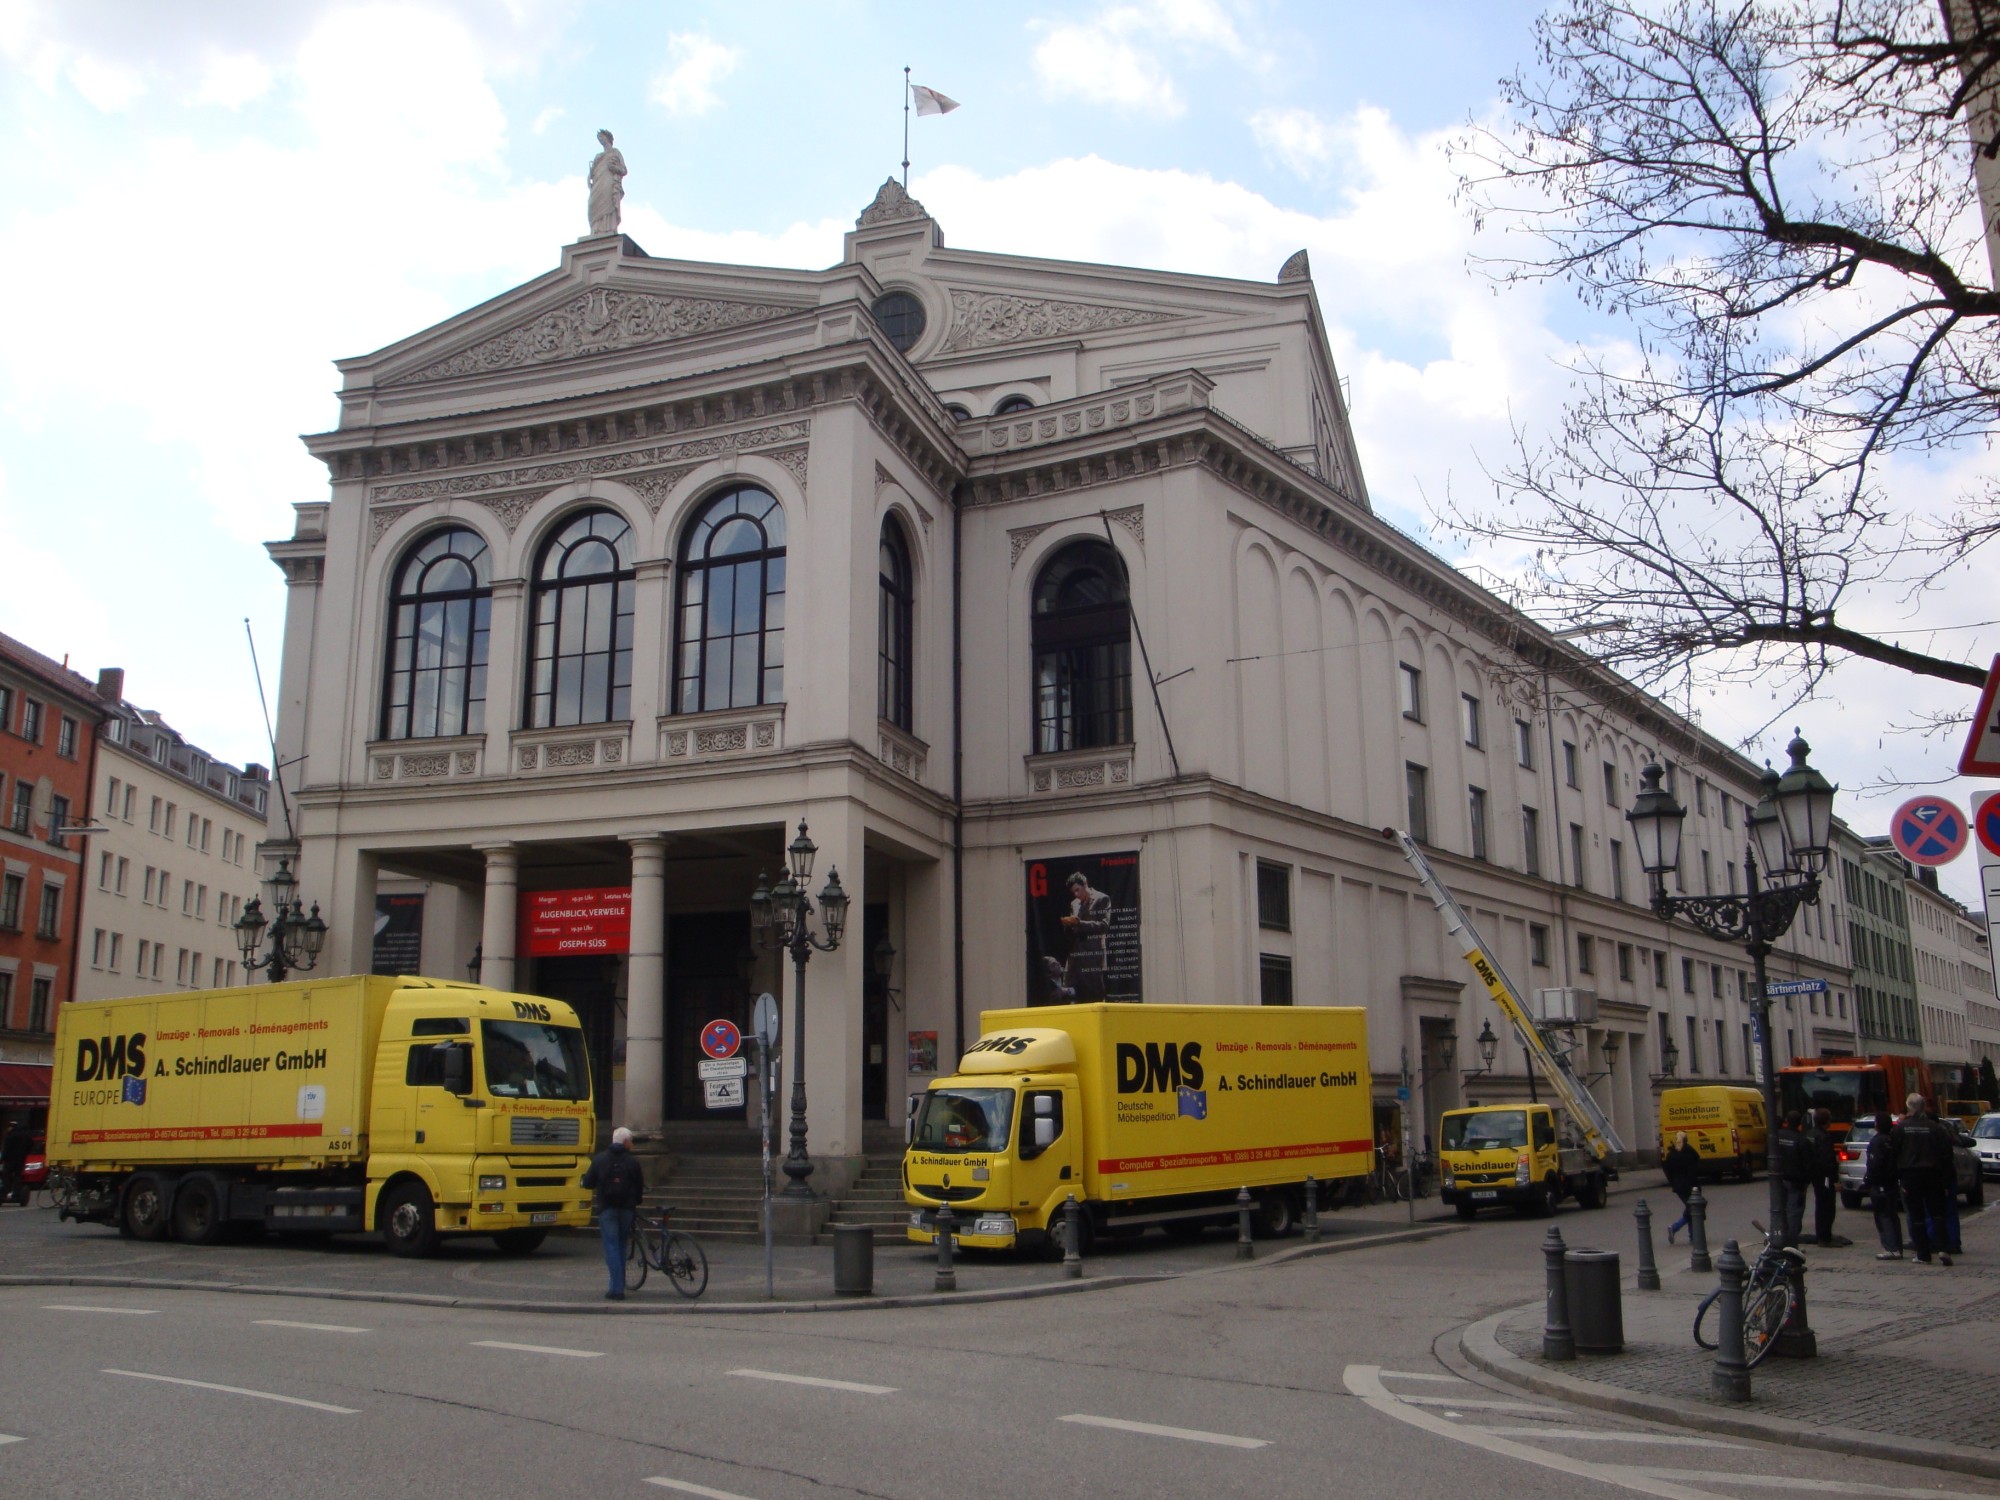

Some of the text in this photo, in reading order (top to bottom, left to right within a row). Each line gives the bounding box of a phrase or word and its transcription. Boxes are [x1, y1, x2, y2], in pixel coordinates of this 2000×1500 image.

[1029, 863, 1048, 898] G
[540, 907, 625, 919] AUGENBLICK, VERWEILE
[559, 938, 607, 950] JOSEPH SÜSS
[1474, 959, 1497, 987] DMS
[1766, 981, 1821, 995] ärtnerplatz
[511, 1001, 551, 1021] DMS
[157, 1020, 328, 1041] Umzüge Removals Déménagements
[964, 1036, 1037, 1055] DMS
[1216, 1041, 1358, 1053] Umzüge Removals Déménagements
[76, 1032, 147, 1082] DMS
[154, 1049, 327, 1077] A. Schindlauer GmbH
[1116, 1041, 1204, 1094] DMS
[1218, 1071, 1357, 1091] A. Schindlauer GmbH
[73, 1089, 120, 1106] EUROPE
[501, 1103, 510, 1113] A.
[1117, 1100, 1154, 1112] Deutsche
[1669, 1106, 1720, 1116] Schindlauer
[1117, 1112, 1176, 1123] Möbelspedition
[210, 1129, 220, 1137] Tel.
[328, 1141, 351, 1150] AS 01
[912, 1156, 988, 1167] A. Schindlauer GmbH
[1119, 1161, 1154, 1171] Computer
[1159, 1155, 1217, 1169] Spezialtransporte
[1222, 1153, 1233, 1162] Tel.
[1234, 1152, 1250, 1162] (089)
[1453, 1161, 1516, 1172] Schindlauer
